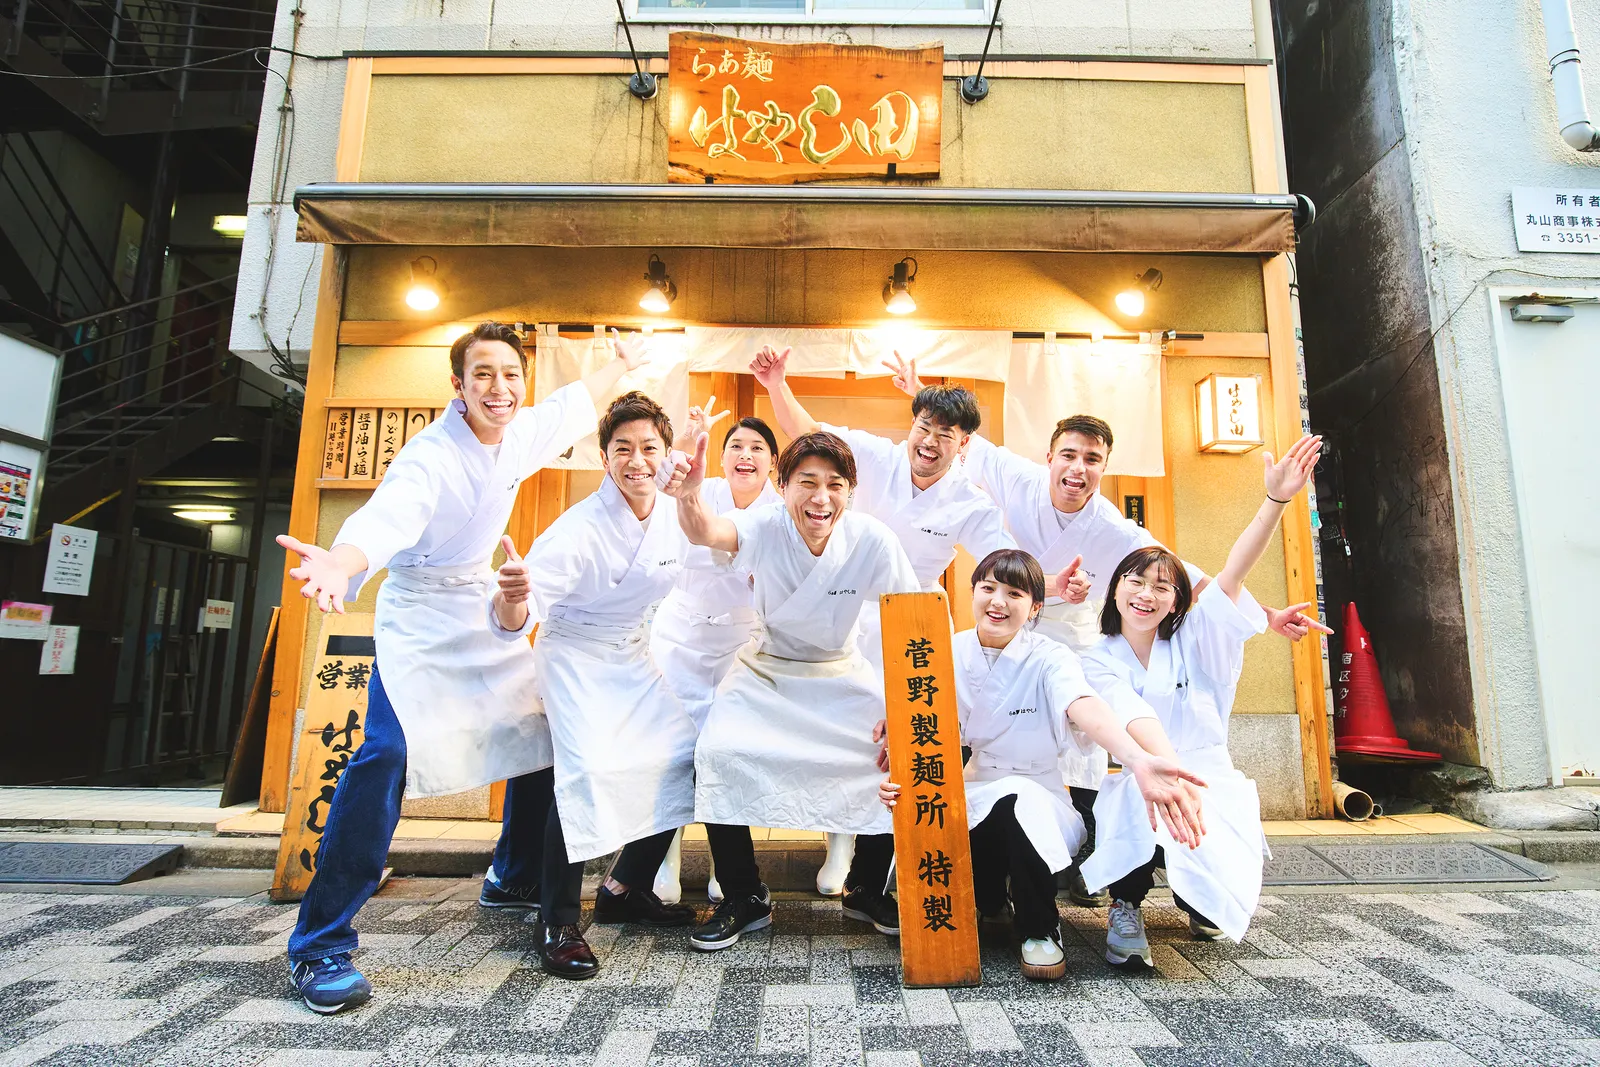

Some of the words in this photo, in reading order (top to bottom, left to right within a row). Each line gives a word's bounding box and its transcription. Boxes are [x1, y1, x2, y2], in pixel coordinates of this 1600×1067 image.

[688, 83, 920, 165] はやし田
[1556, 194, 1600, 207] 所有者
[1557, 232, 1600, 244] 3351-
[1228, 383, 1244, 437] はやし田
[316, 660, 371, 690] 営業
[904, 637, 949, 831] 菅野製麺所
[917, 849, 958, 933] 特製
